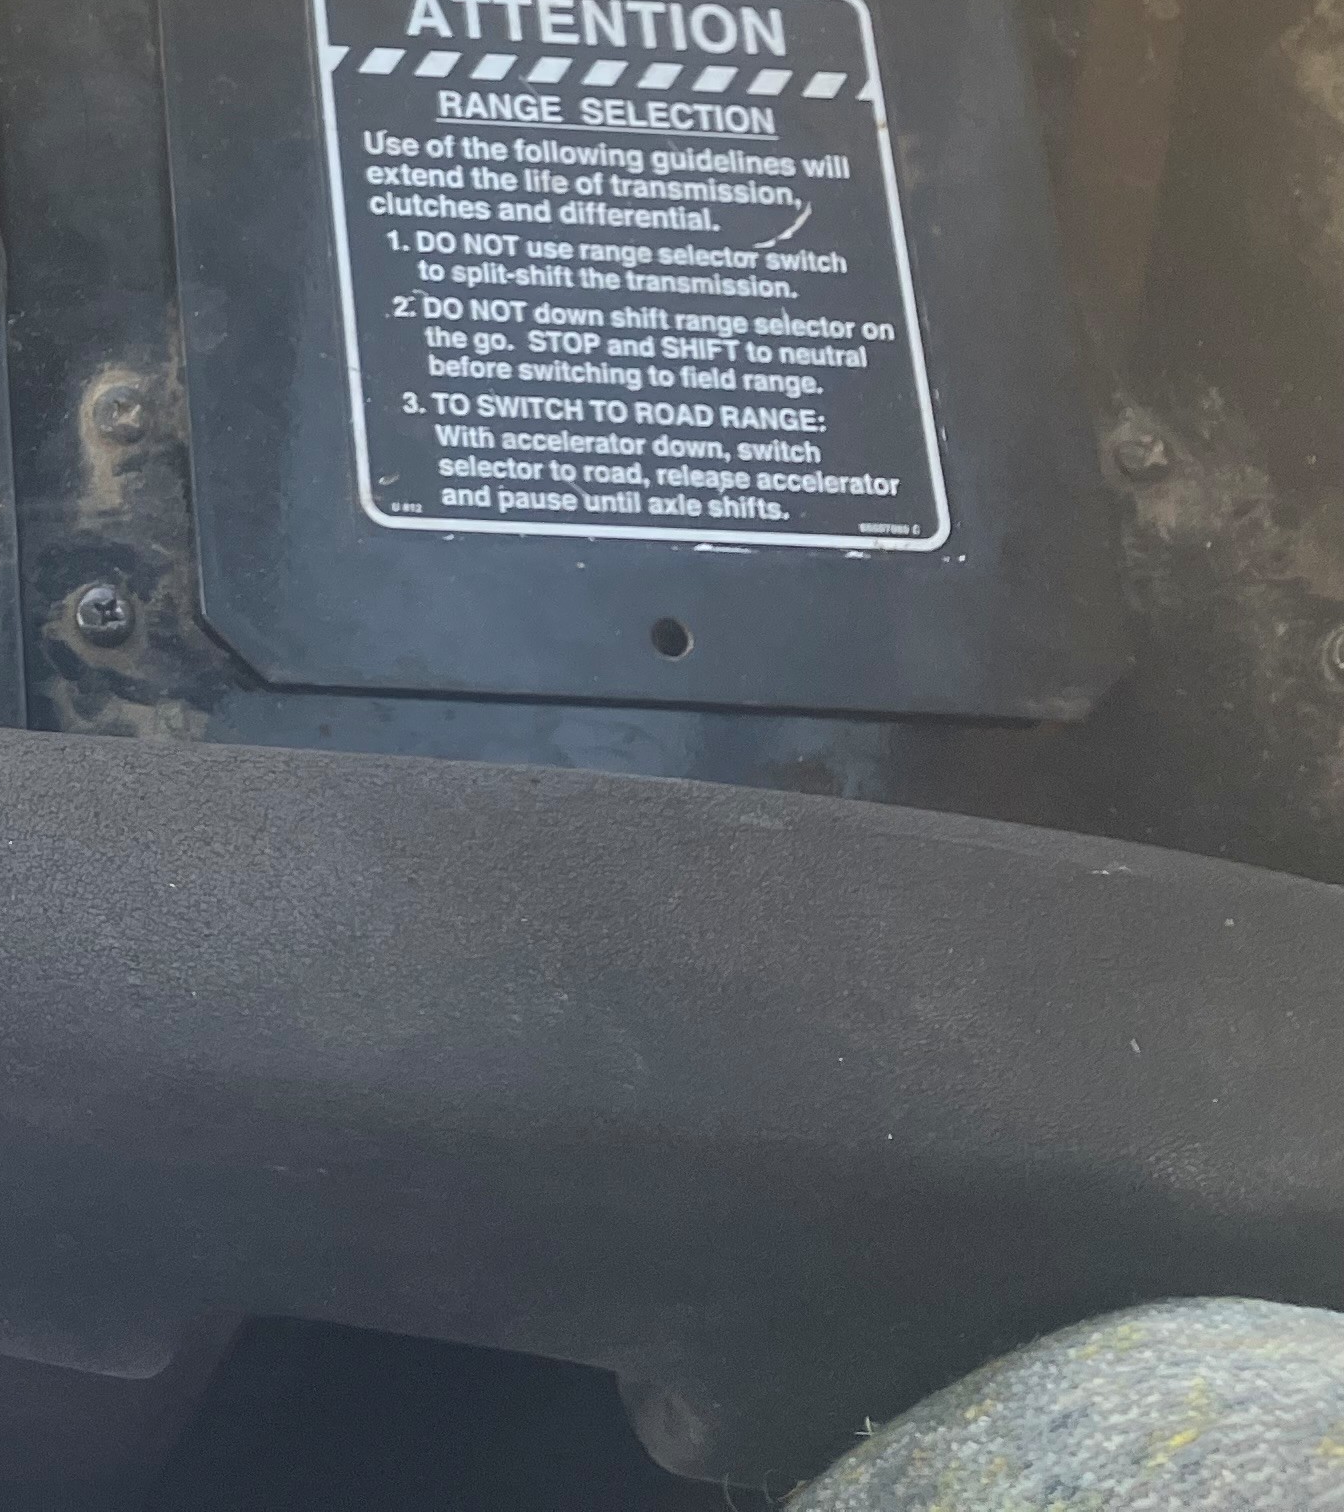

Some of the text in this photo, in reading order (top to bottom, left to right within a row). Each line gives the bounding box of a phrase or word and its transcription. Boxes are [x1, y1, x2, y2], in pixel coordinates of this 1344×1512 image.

[438, 91, 775, 133] RANGE SELECTION
[364, 130, 849, 178] Use following guidelines will
[366, 164, 803, 209] extend life transmission,
[370, 192, 720, 231] clutches differential.
[416, 231, 847, 273] DO NOT range selector switch
[452, 262, 797, 298] split-shift transmission.
[423, 296, 855, 338] DO NOT down shift range selector
[473, 330, 867, 367] go. STOP SHIFT neutral
[429, 354, 823, 398] before switching field range.
[477, 395, 826, 432] SWITCH ROAD RANGE:
[435, 424, 820, 463] With accelerator down, switch
[439, 455, 899, 495] selector road, release accelerator
[498, 491, 789, 520] pause until axle shifts.
